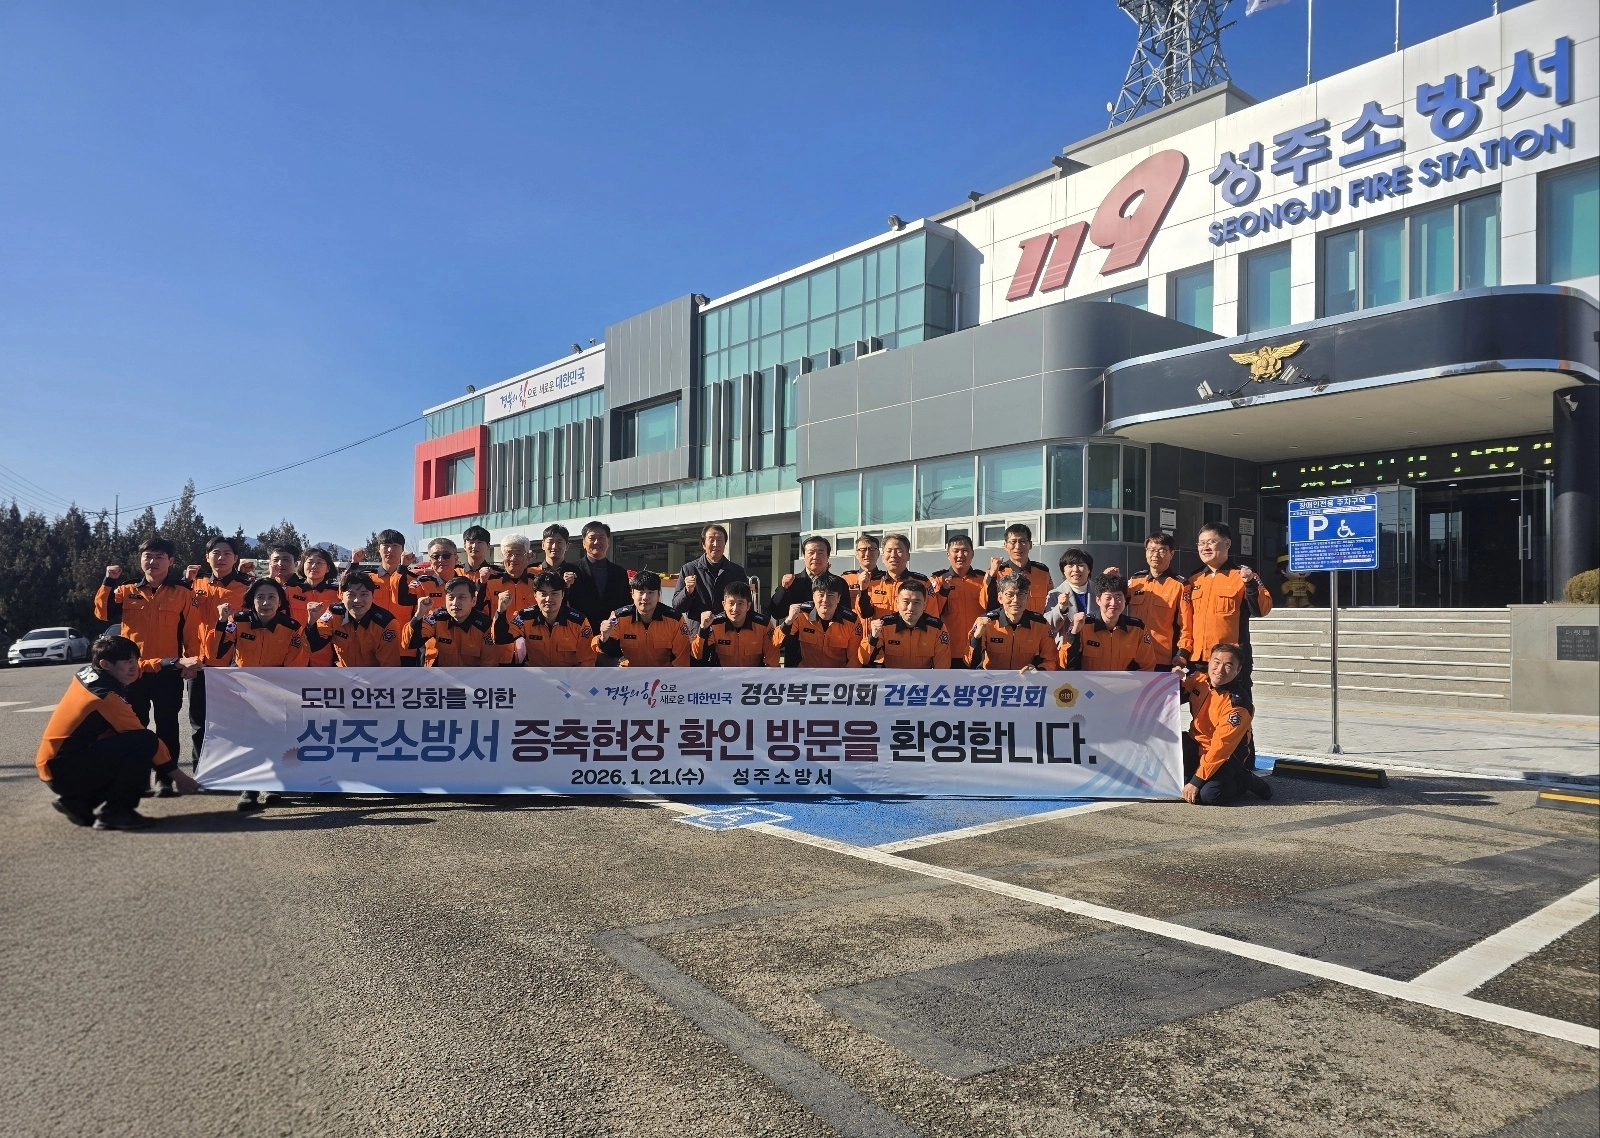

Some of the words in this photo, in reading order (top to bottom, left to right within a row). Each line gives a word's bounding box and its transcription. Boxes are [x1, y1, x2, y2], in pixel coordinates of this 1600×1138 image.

[1209, 36, 1575, 207] 성주소방서
[1209, 186, 1341, 247] SEONGJU
[1349, 165, 1413, 208] FIRE
[1418, 118, 1575, 188] STATION
[1005, 149, 1190, 302] 119
[555, 367, 585, 389] 대한민국
[1299, 499, 1334, 510] 장애인전용
[1336, 497, 1366, 506] 주차구역
[1308, 515, 1329, 541] P
[300, 688, 345, 709] 도민
[351, 688, 395, 709] 안전
[401, 688, 467, 710] 강화를
[472, 688, 516, 709] 위한
[604, 686, 639, 706] 경북의
[660, 694, 685, 705] 새로운
[687, 692, 732, 705] 대한민국
[740, 684, 878, 707] 경상북도의회
[883, 684, 1048, 708] 건설소방위원회
[297, 719, 499, 763] 성주소방서
[511, 719, 669, 763] 증축현장
[677, 718, 755, 763] 확인
[766, 719, 881, 763] 방문을
[889, 719, 1098, 765] 환영합니다.
[732, 768, 832, 786] 성주소방서
